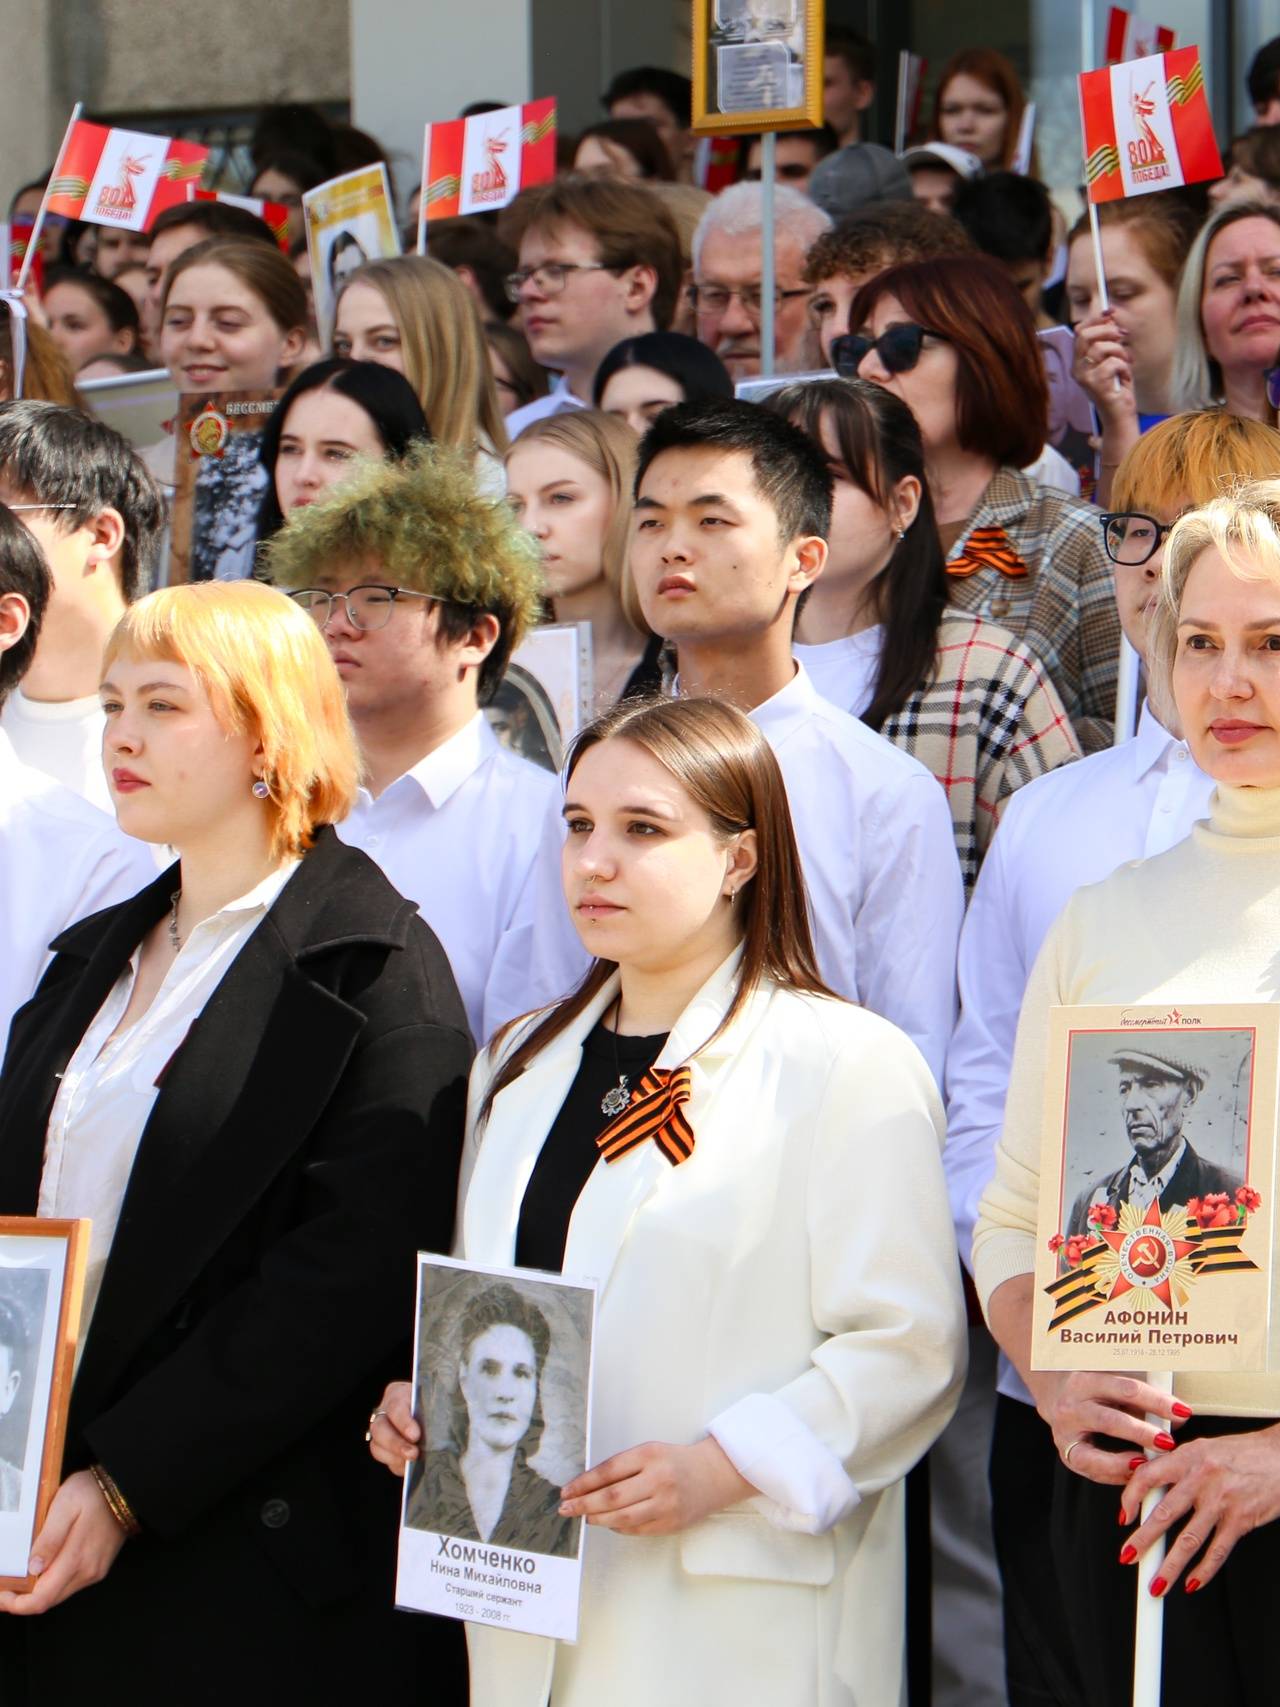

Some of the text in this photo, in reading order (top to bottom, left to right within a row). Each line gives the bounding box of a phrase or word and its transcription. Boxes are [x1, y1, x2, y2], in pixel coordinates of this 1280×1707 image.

[1128, 139, 1149, 168] 80
[1104, 1310, 1188, 1326] АФОНИН
[1060, 1328, 1238, 1347] Василий Петрович
[437, 1535, 536, 1575] Хомченко
[430, 1559, 543, 1595] Нина Михайловна
[445, 1582, 523, 1608] Старший сержант
[455, 1602, 475, 1616] 1923
[481, 1607, 501, 1622] 2008
